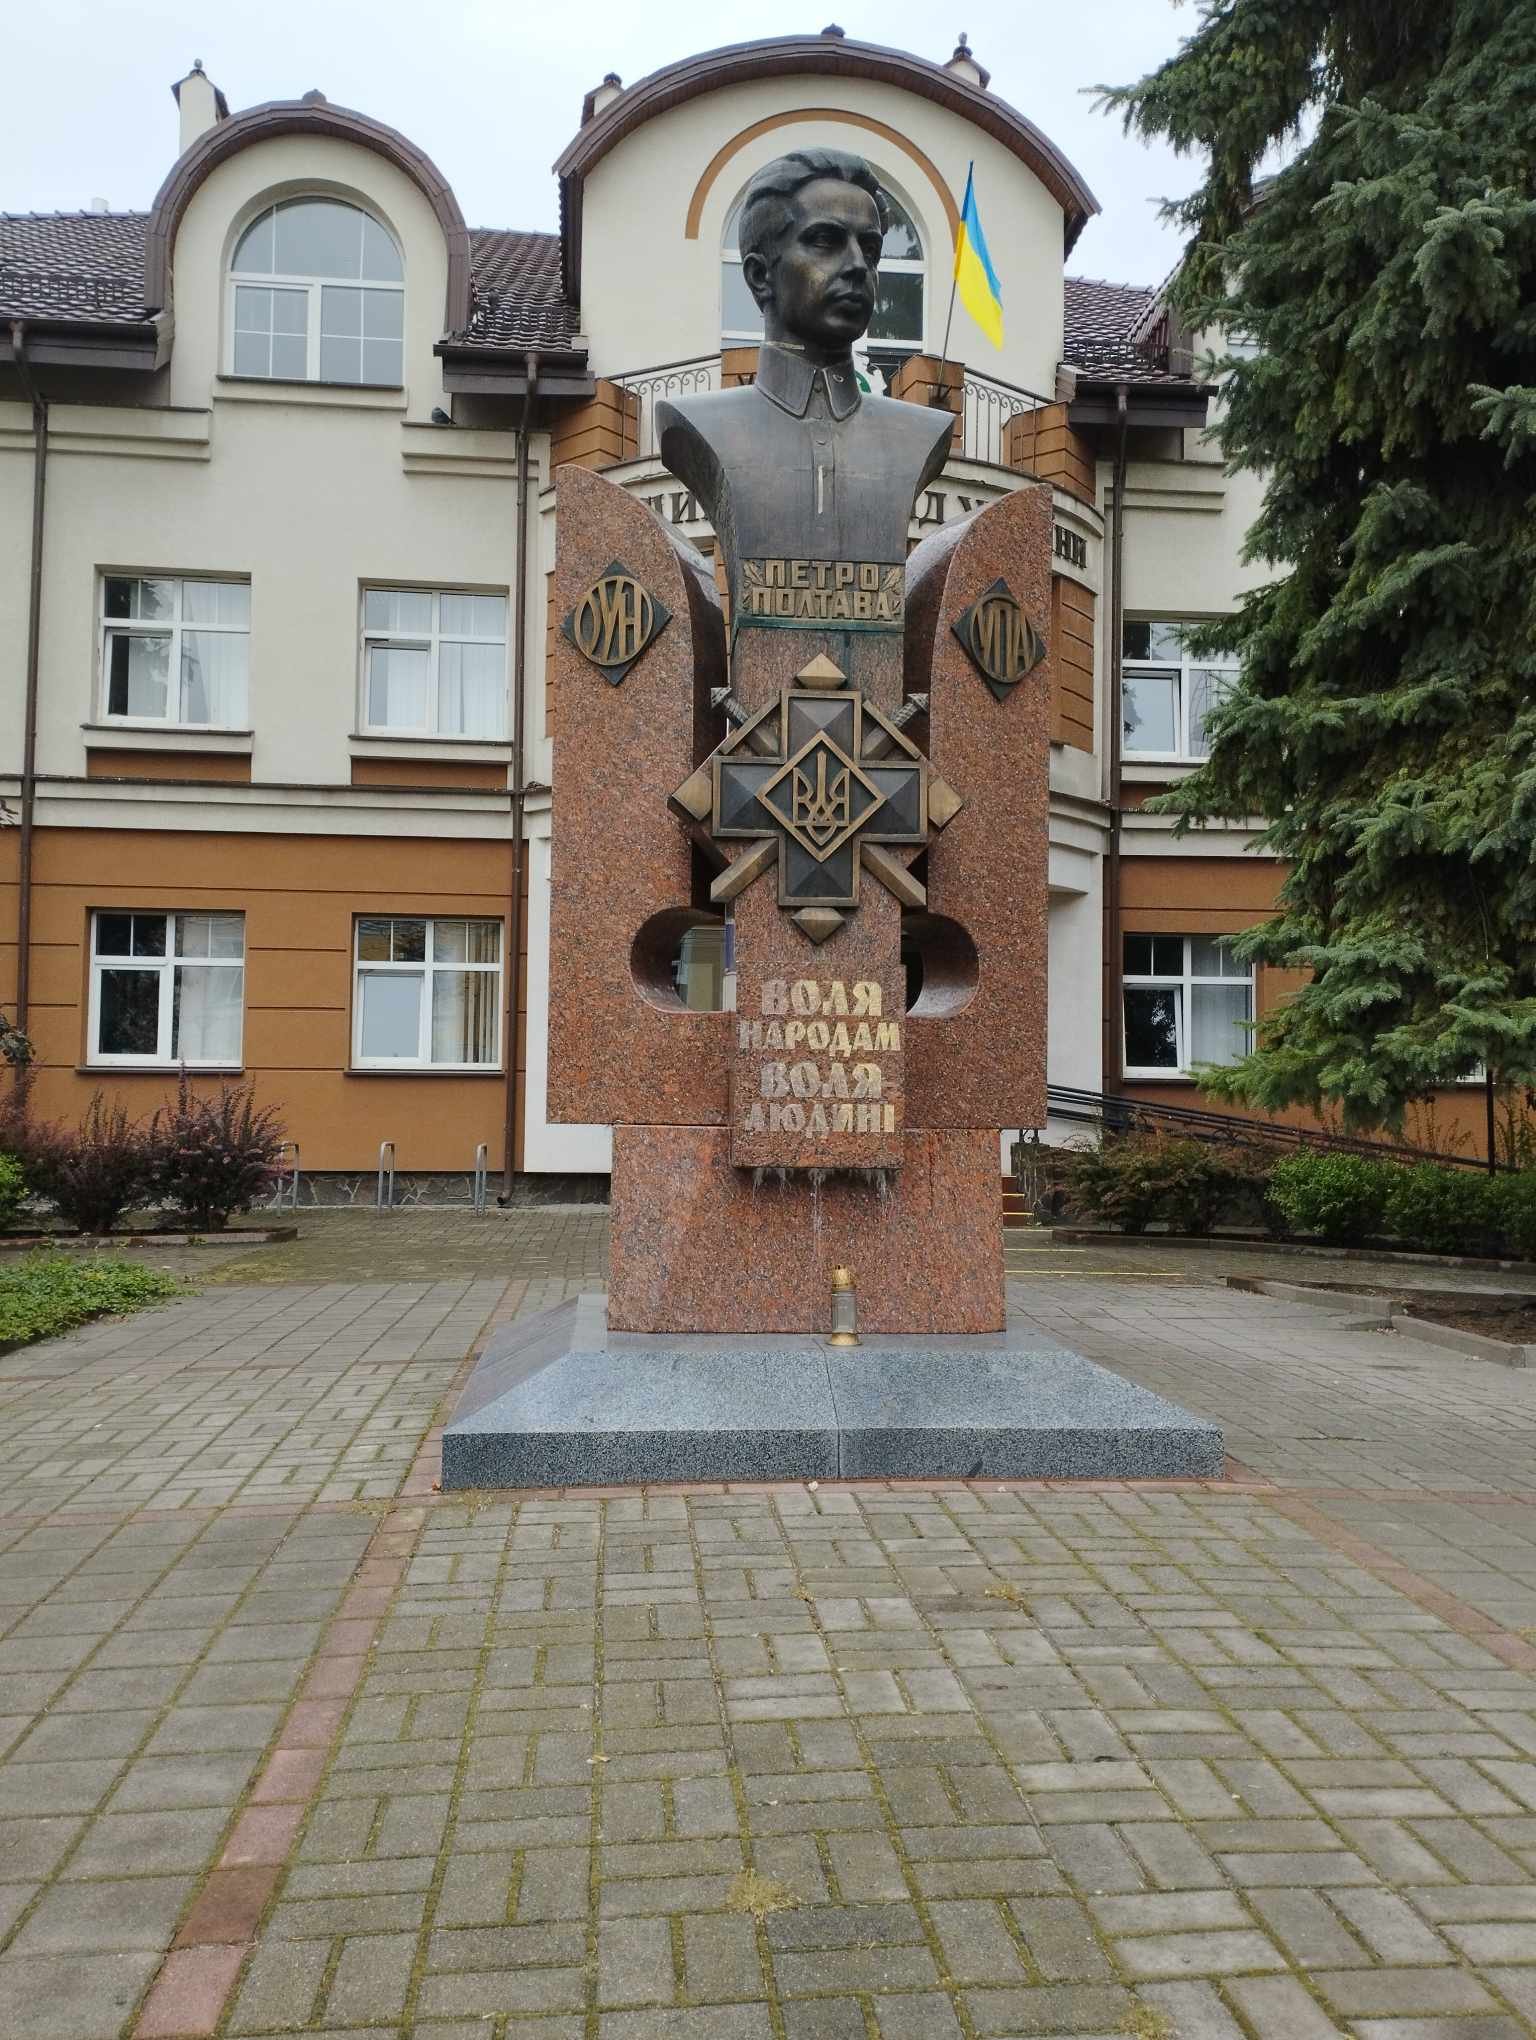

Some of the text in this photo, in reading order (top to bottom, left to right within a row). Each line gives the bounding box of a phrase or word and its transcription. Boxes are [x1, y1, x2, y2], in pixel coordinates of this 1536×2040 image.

[765, 560, 880, 591] ПЕТРО
[752, 587, 893, 621] ПОЛТАВА
[762, 979, 882, 1016] ВОЛЯ
[739, 1020, 901, 1057] НАРОДАМ
[760, 1062, 882, 1098] ВОЛЯ
[744, 1103, 895, 1138] ЛЮДИНІ
